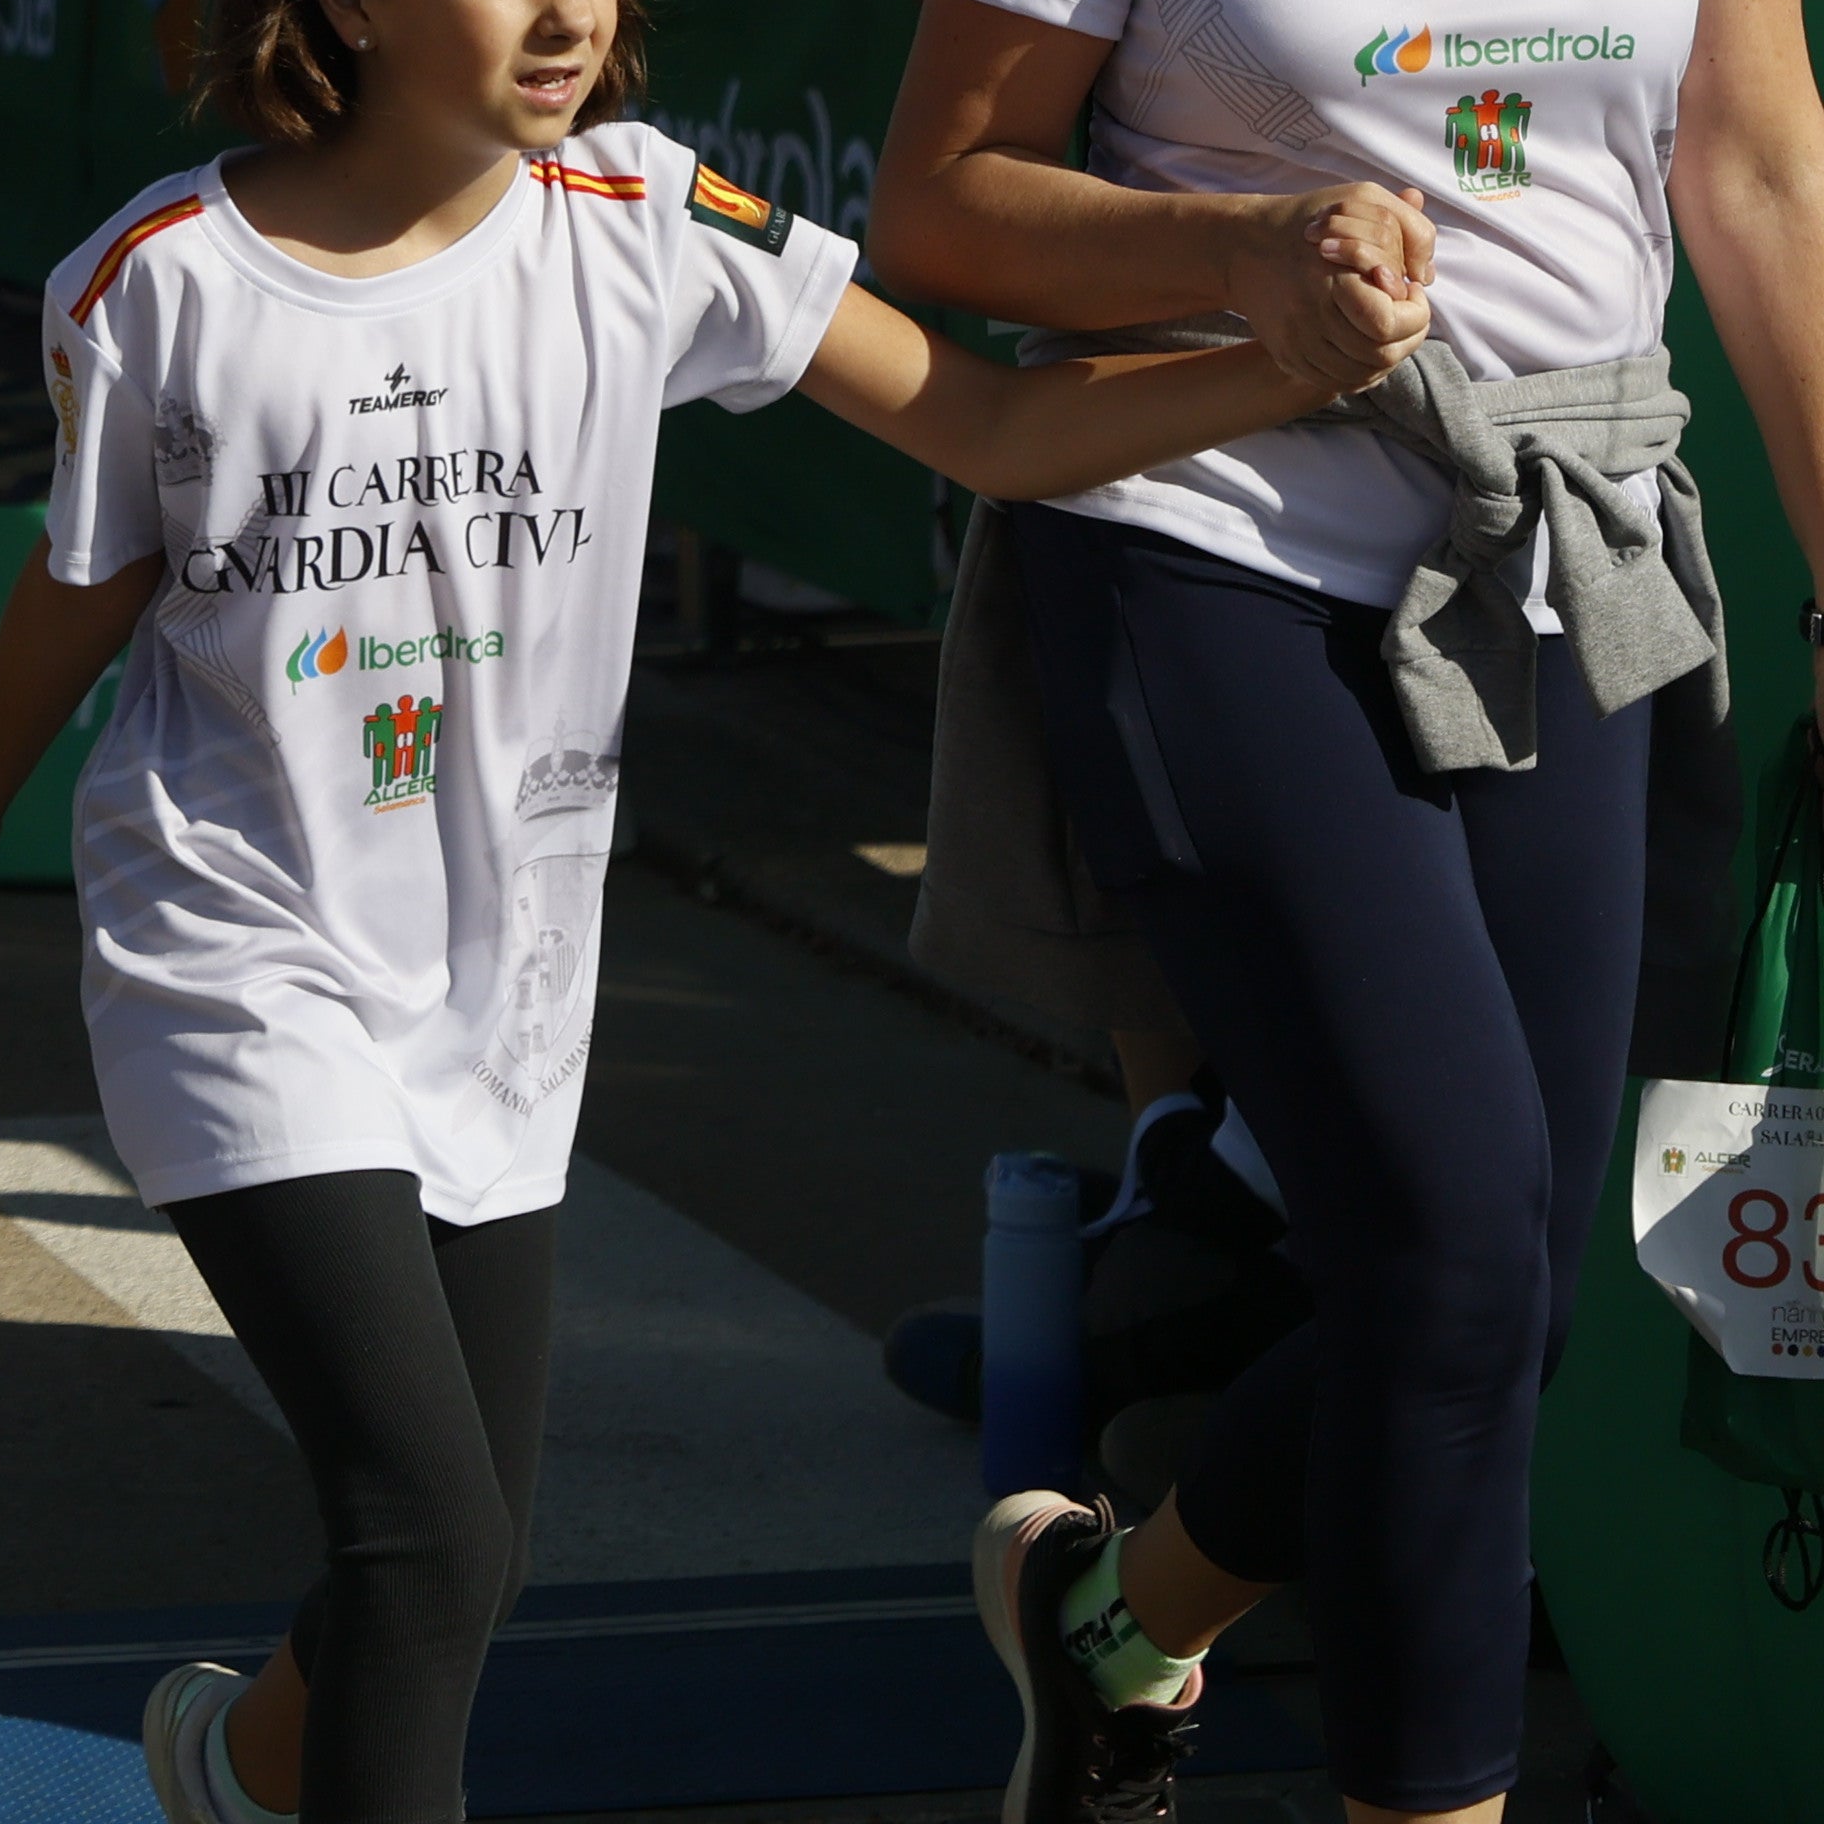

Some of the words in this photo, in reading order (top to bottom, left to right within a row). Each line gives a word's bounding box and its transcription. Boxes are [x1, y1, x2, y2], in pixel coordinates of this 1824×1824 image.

[1443, 26, 1634, 68] Iberdrola
[1458, 172, 1532, 193] ALCER
[349, 387, 448, 415] TEAMERGY
[328, 447, 543, 508] CARRERA
[181, 520, 445, 594] GVARDIA
[1729, 1101, 1814, 1120] CARRERA
[1694, 1151, 1751, 1168] ALCER
